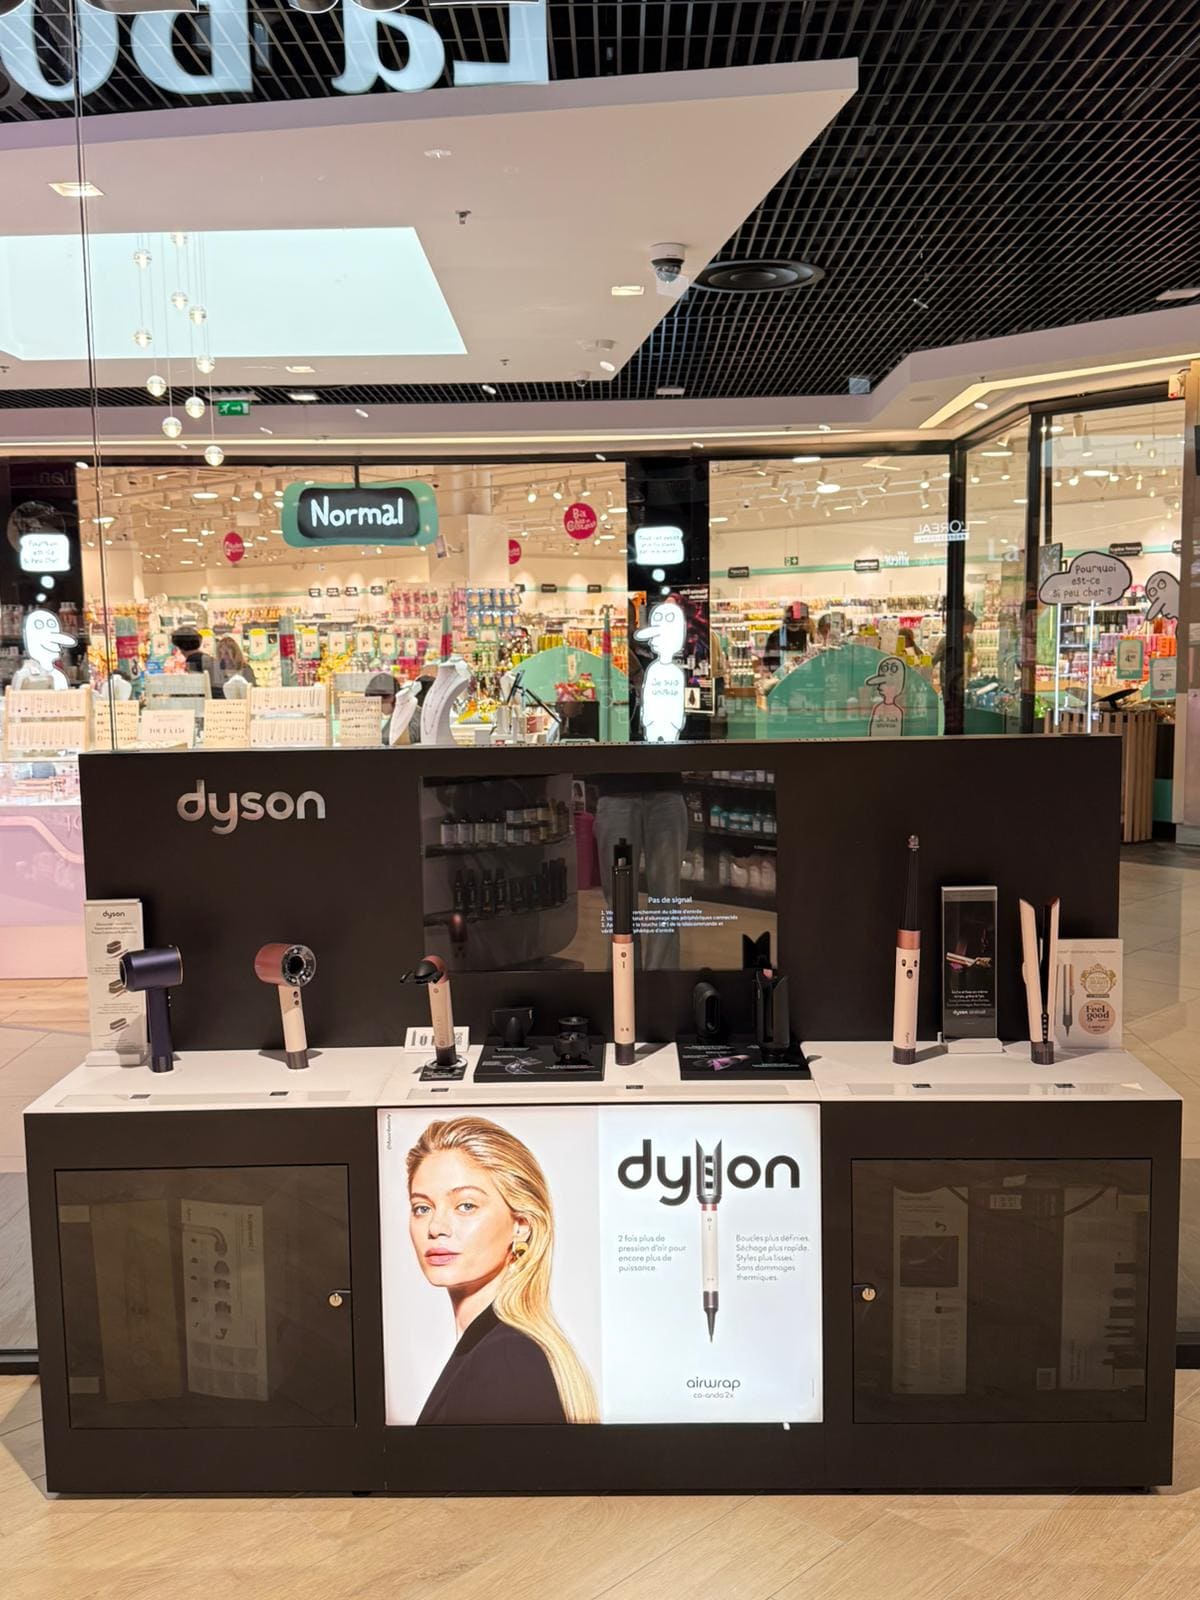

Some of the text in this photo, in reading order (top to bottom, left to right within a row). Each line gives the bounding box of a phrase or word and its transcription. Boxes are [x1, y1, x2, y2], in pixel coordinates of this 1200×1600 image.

[310, 495, 404, 528] Normal
[1075, 563, 1117, 575] Pourquoi
[1071, 577, 1101, 586] est-ce
[1063, 590, 1080, 599] peu
[1083, 587, 1105, 597] cher
[176, 779, 326, 835] dyson
[648, 896, 693, 905] Pas de signal
[102, 910, 126, 919] dyson
[1086, 1011, 1110, 1021] good
[624, 1234, 638, 1242] fois
[639, 1234, 654, 1244] plus
[656, 1234, 665, 1242] de
[735, 1234, 764, 1242] Boucles
[764, 1234, 779, 1243] plus
[618, 1244, 687, 1253] pression d'air pour
[735, 1244, 767, 1252] Séchage
[768, 1244, 783, 1252] plus
[645, 1254, 661, 1263] plus
[662, 1254, 672, 1262] de
[735, 1253, 756, 1262] Styles
[758, 1253, 773, 1262] plus
[735, 1263, 796, 1272] Sans dommages
[686, 1376, 741, 1392] airwrap
[693, 1391, 734, 1399] co-anda 2x
